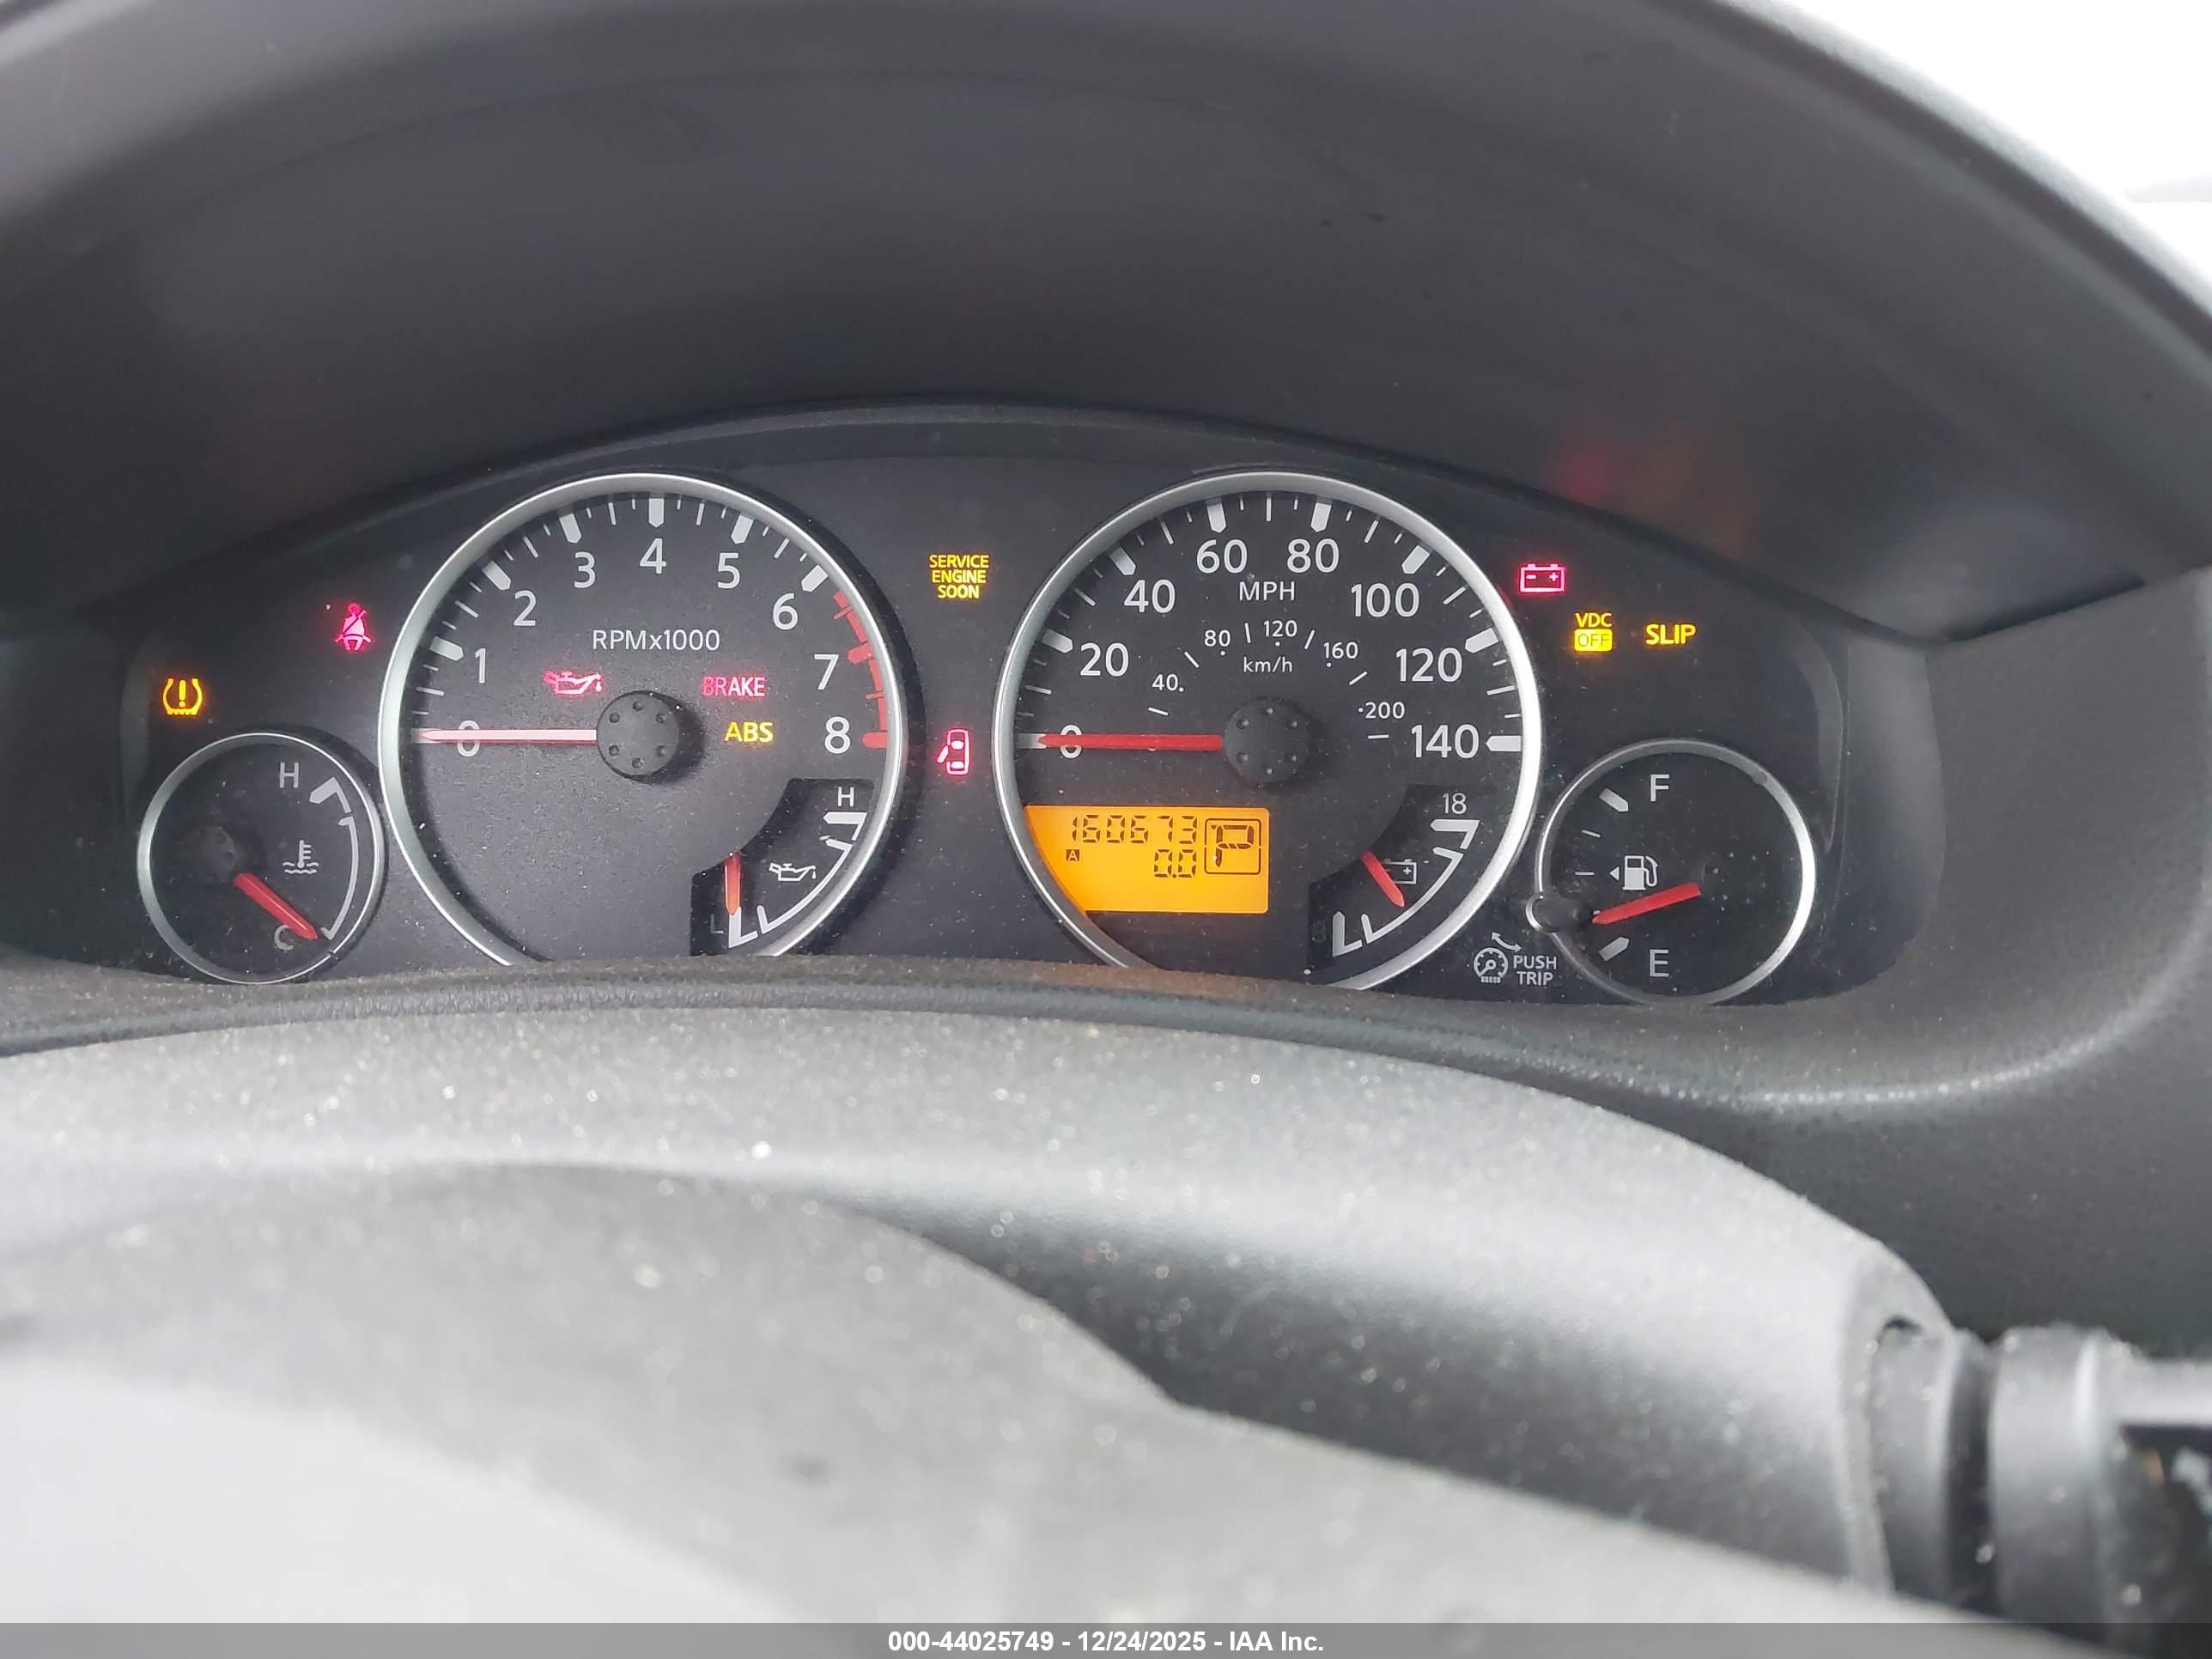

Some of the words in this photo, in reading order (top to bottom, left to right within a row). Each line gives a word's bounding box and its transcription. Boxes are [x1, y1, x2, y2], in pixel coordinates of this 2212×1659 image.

[640, 538, 666, 574] 4
[929, 554, 989, 569] SERVICE
[1196, 539, 1248, 574] 60
[1286, 538, 1340, 574] 80
[574, 552, 596, 589] 3
[718, 552, 739, 589] 5
[931, 569, 987, 585] ENGINE
[937, 584, 980, 599] SOON
[1123, 579, 1176, 614] 40
[1238, 580, 1296, 602] MPH
[1350, 582, 1420, 618] 100
[514, 590, 537, 626] 2
[773, 593, 797, 630] 6
[1576, 612, 1612, 628] VDC
[592, 629, 720, 651] RPMx1000
[1204, 630, 1231, 647] 80
[1263, 620, 1297, 637] 120
[1578, 633, 1609, 647] OFF
[1645, 623, 1696, 646] SLIP
[1079, 643, 1128, 678] 20
[1323, 641, 1358, 659] 160
[475, 648, 485, 684] 1
[813, 654, 839, 690] 7
[1243, 657, 1292, 672] km/h
[1395, 647, 1463, 683] 120
[702, 676, 767, 697] BRAKE
[1365, 701, 1405, 719] 200
[457, 720, 479, 757] 0
[725, 721, 774, 743] ABS
[824, 716, 851, 754] 8
[1059, 725, 1083, 759] 0
[1410, 723, 1480, 759] 140
[280, 762, 299, 788] H
[1650, 775, 1670, 801] F
[838, 787, 854, 806] H
[1442, 792, 1467, 814] 18
[1073, 815, 1198, 844] 160673
[1066, 849, 1079, 861] A
[1212, 824, 1255, 867] P
[1154, 849, 1197, 878] 0.0
[1514, 955, 1558, 970] PUSH
[1650, 949, 1669, 977] E
[1516, 971, 1553, 986] TRIP
